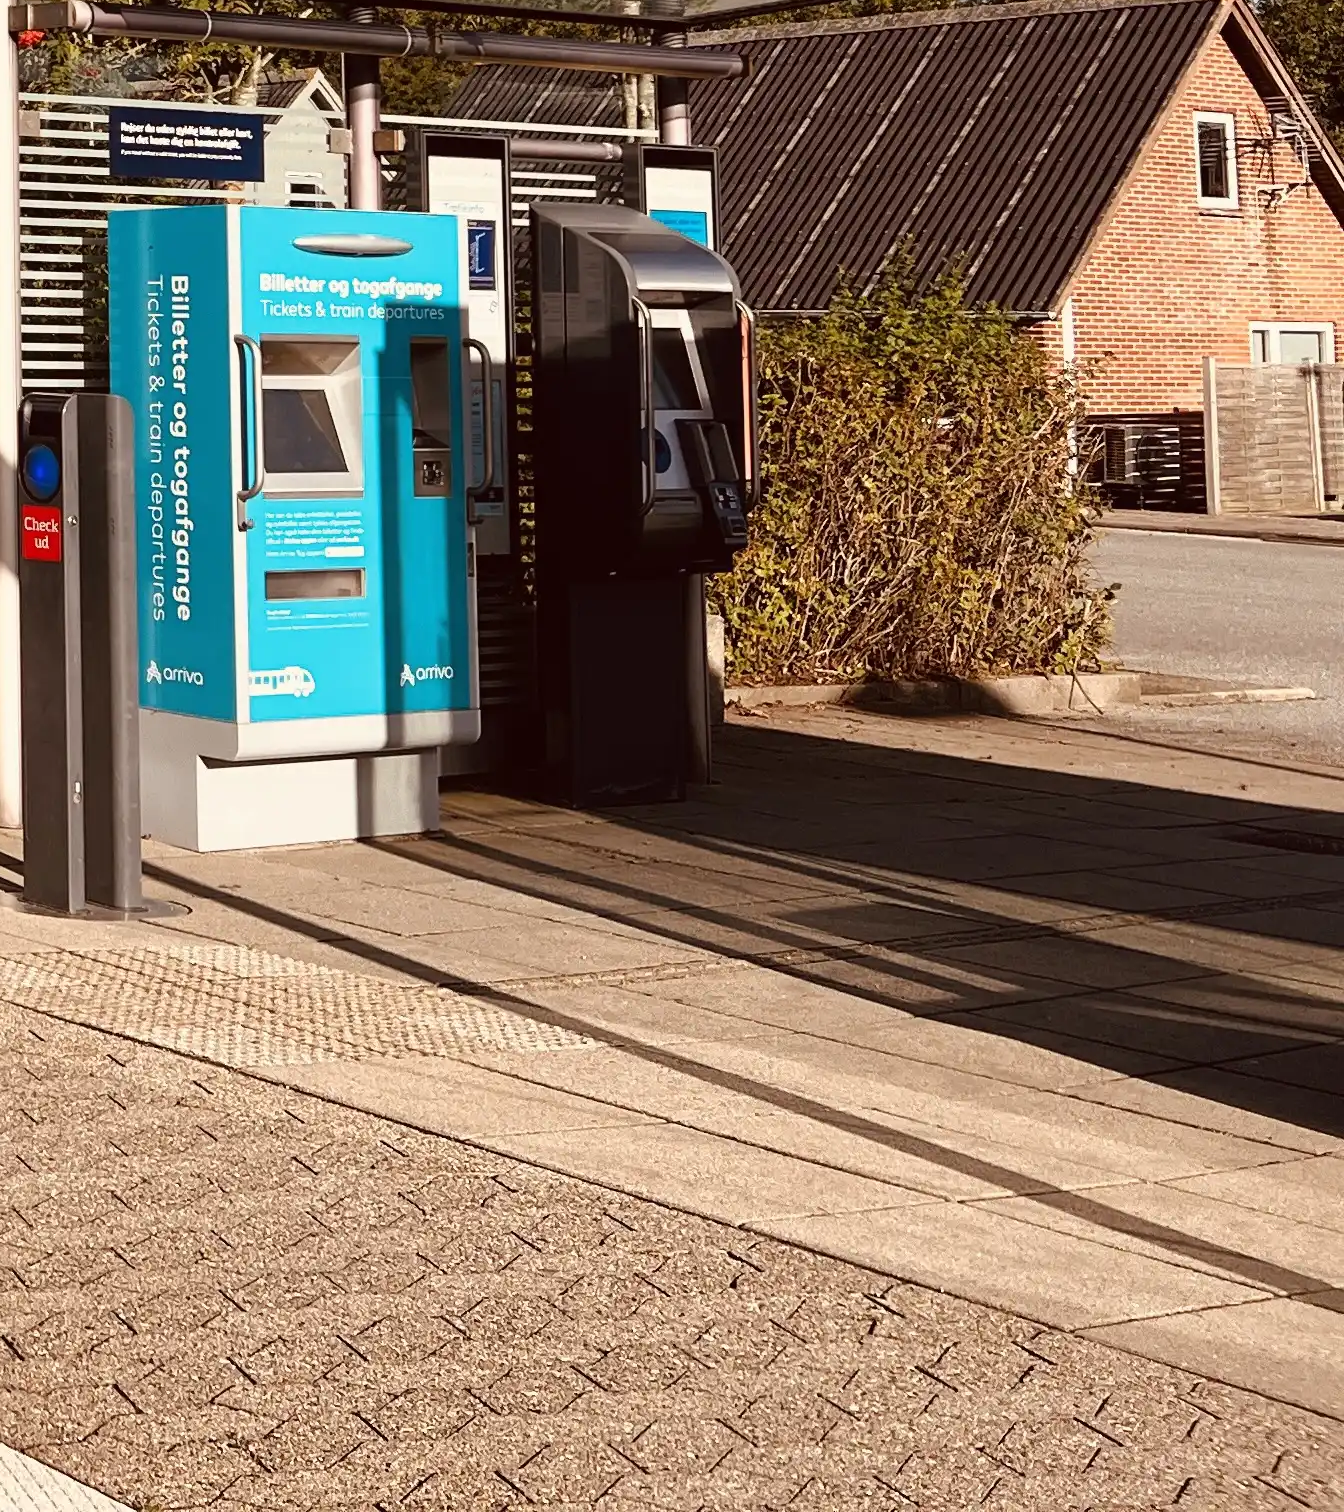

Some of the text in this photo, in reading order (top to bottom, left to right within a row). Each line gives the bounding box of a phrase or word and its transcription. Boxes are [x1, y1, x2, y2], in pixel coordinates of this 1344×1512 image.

[260, 273, 443, 300] Billetter og togafgange
[260, 300, 444, 322] Tickets & train departures
[147, 275, 167, 621] Tickets & train departures
[169, 275, 194, 621] Billetter og togafgange
[24, 516, 59, 533] Check
[34, 535, 50, 549] ud
[163, 665, 204, 686] arriva
[415, 664, 454, 681] arriva
